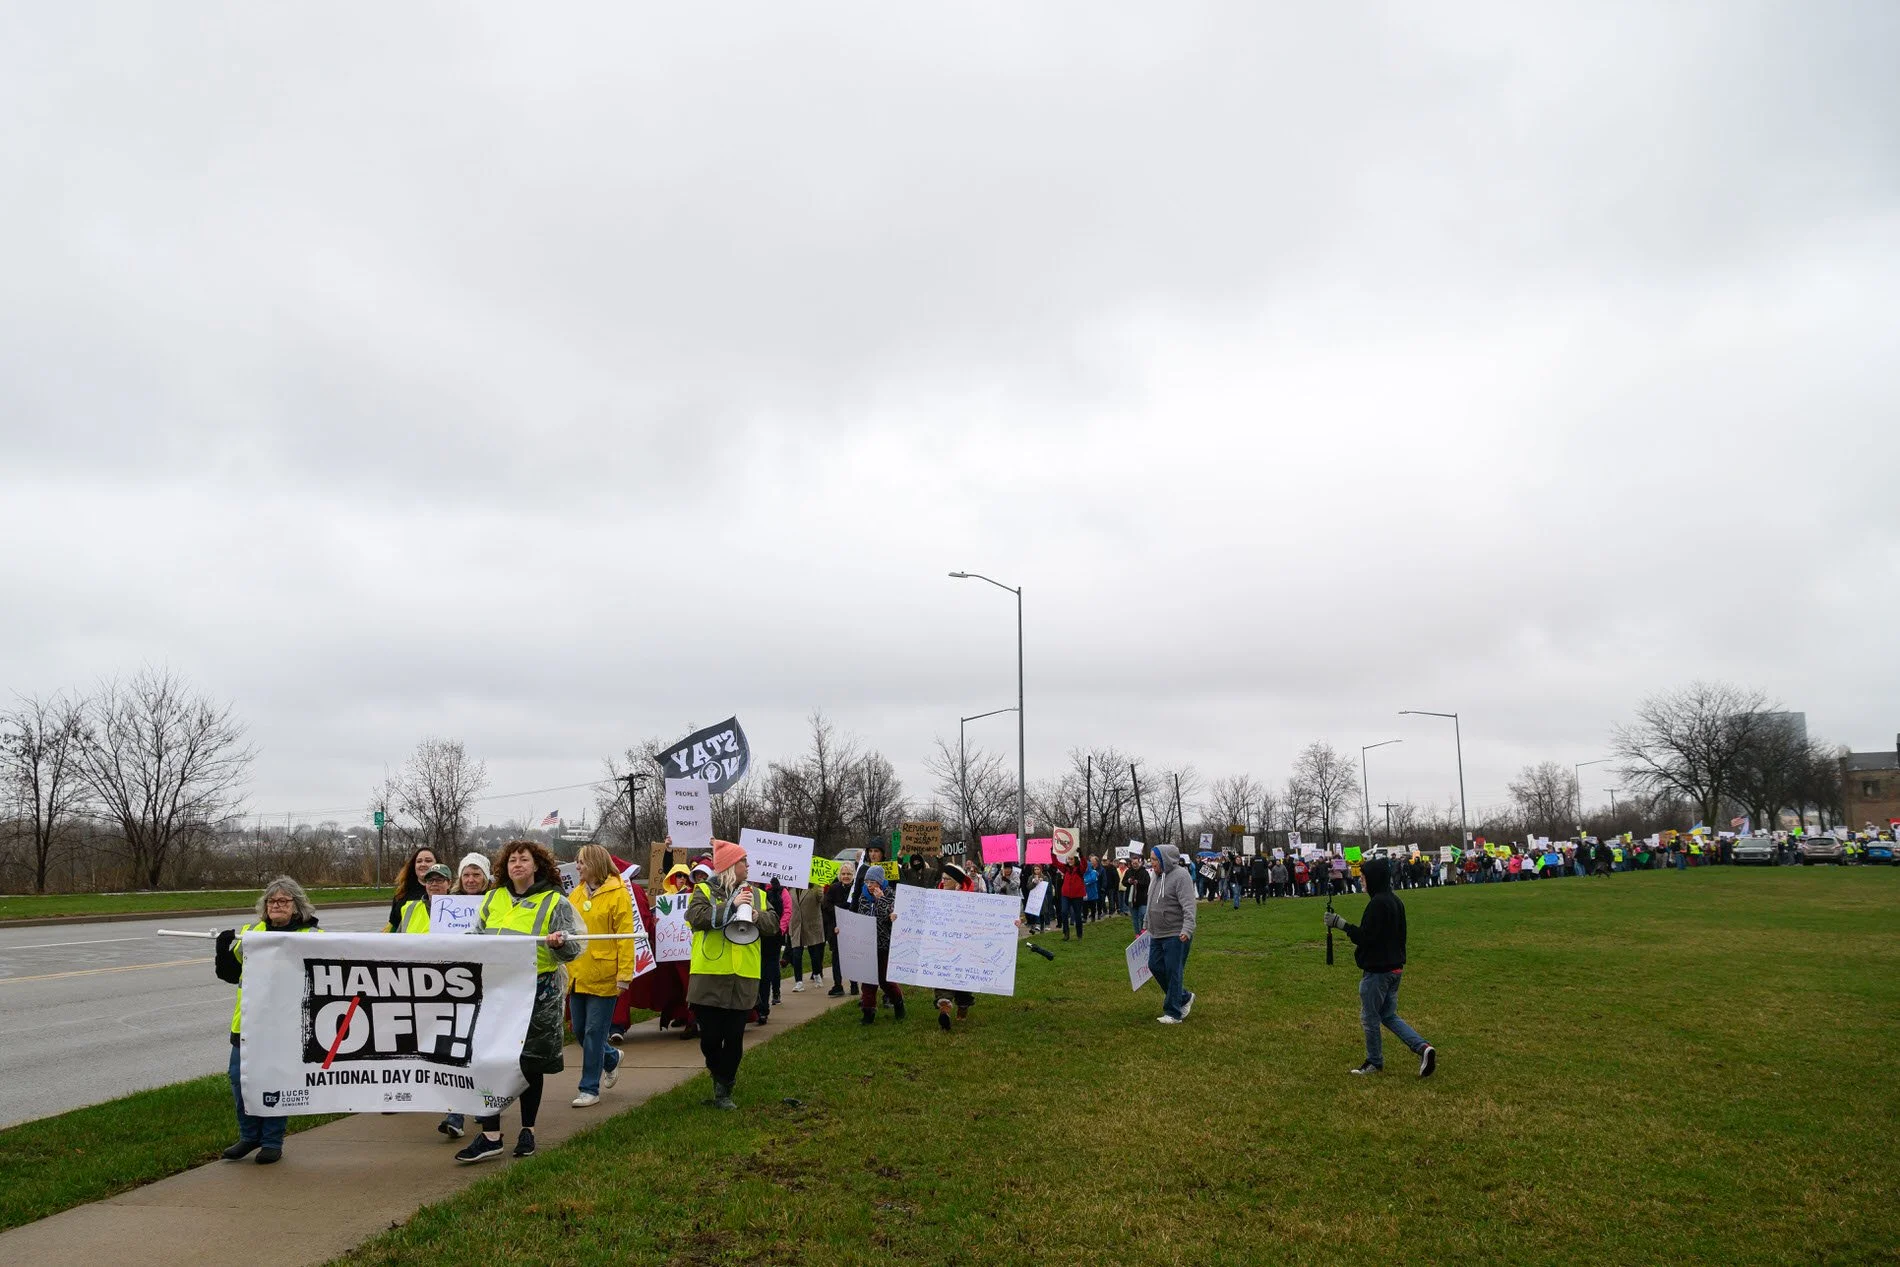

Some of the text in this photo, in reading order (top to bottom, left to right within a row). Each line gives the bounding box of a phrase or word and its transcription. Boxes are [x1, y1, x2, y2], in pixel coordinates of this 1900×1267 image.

[756, 837, 803, 851] HANDS OFF
[941, 841, 966, 856] NOUGH
[756, 859, 793, 872] WAKE UP
[813, 859, 832, 870] HIS
[761, 871, 797, 881] AMERICA!
[811, 867, 839, 879] MUSK
[313, 965, 476, 998] HANDS
[314, 1000, 476, 1059] OFF!
[306, 1069, 475, 1090] NATIONAL DAY OF ACTION
[281, 1089, 309, 1097] LUCAS
